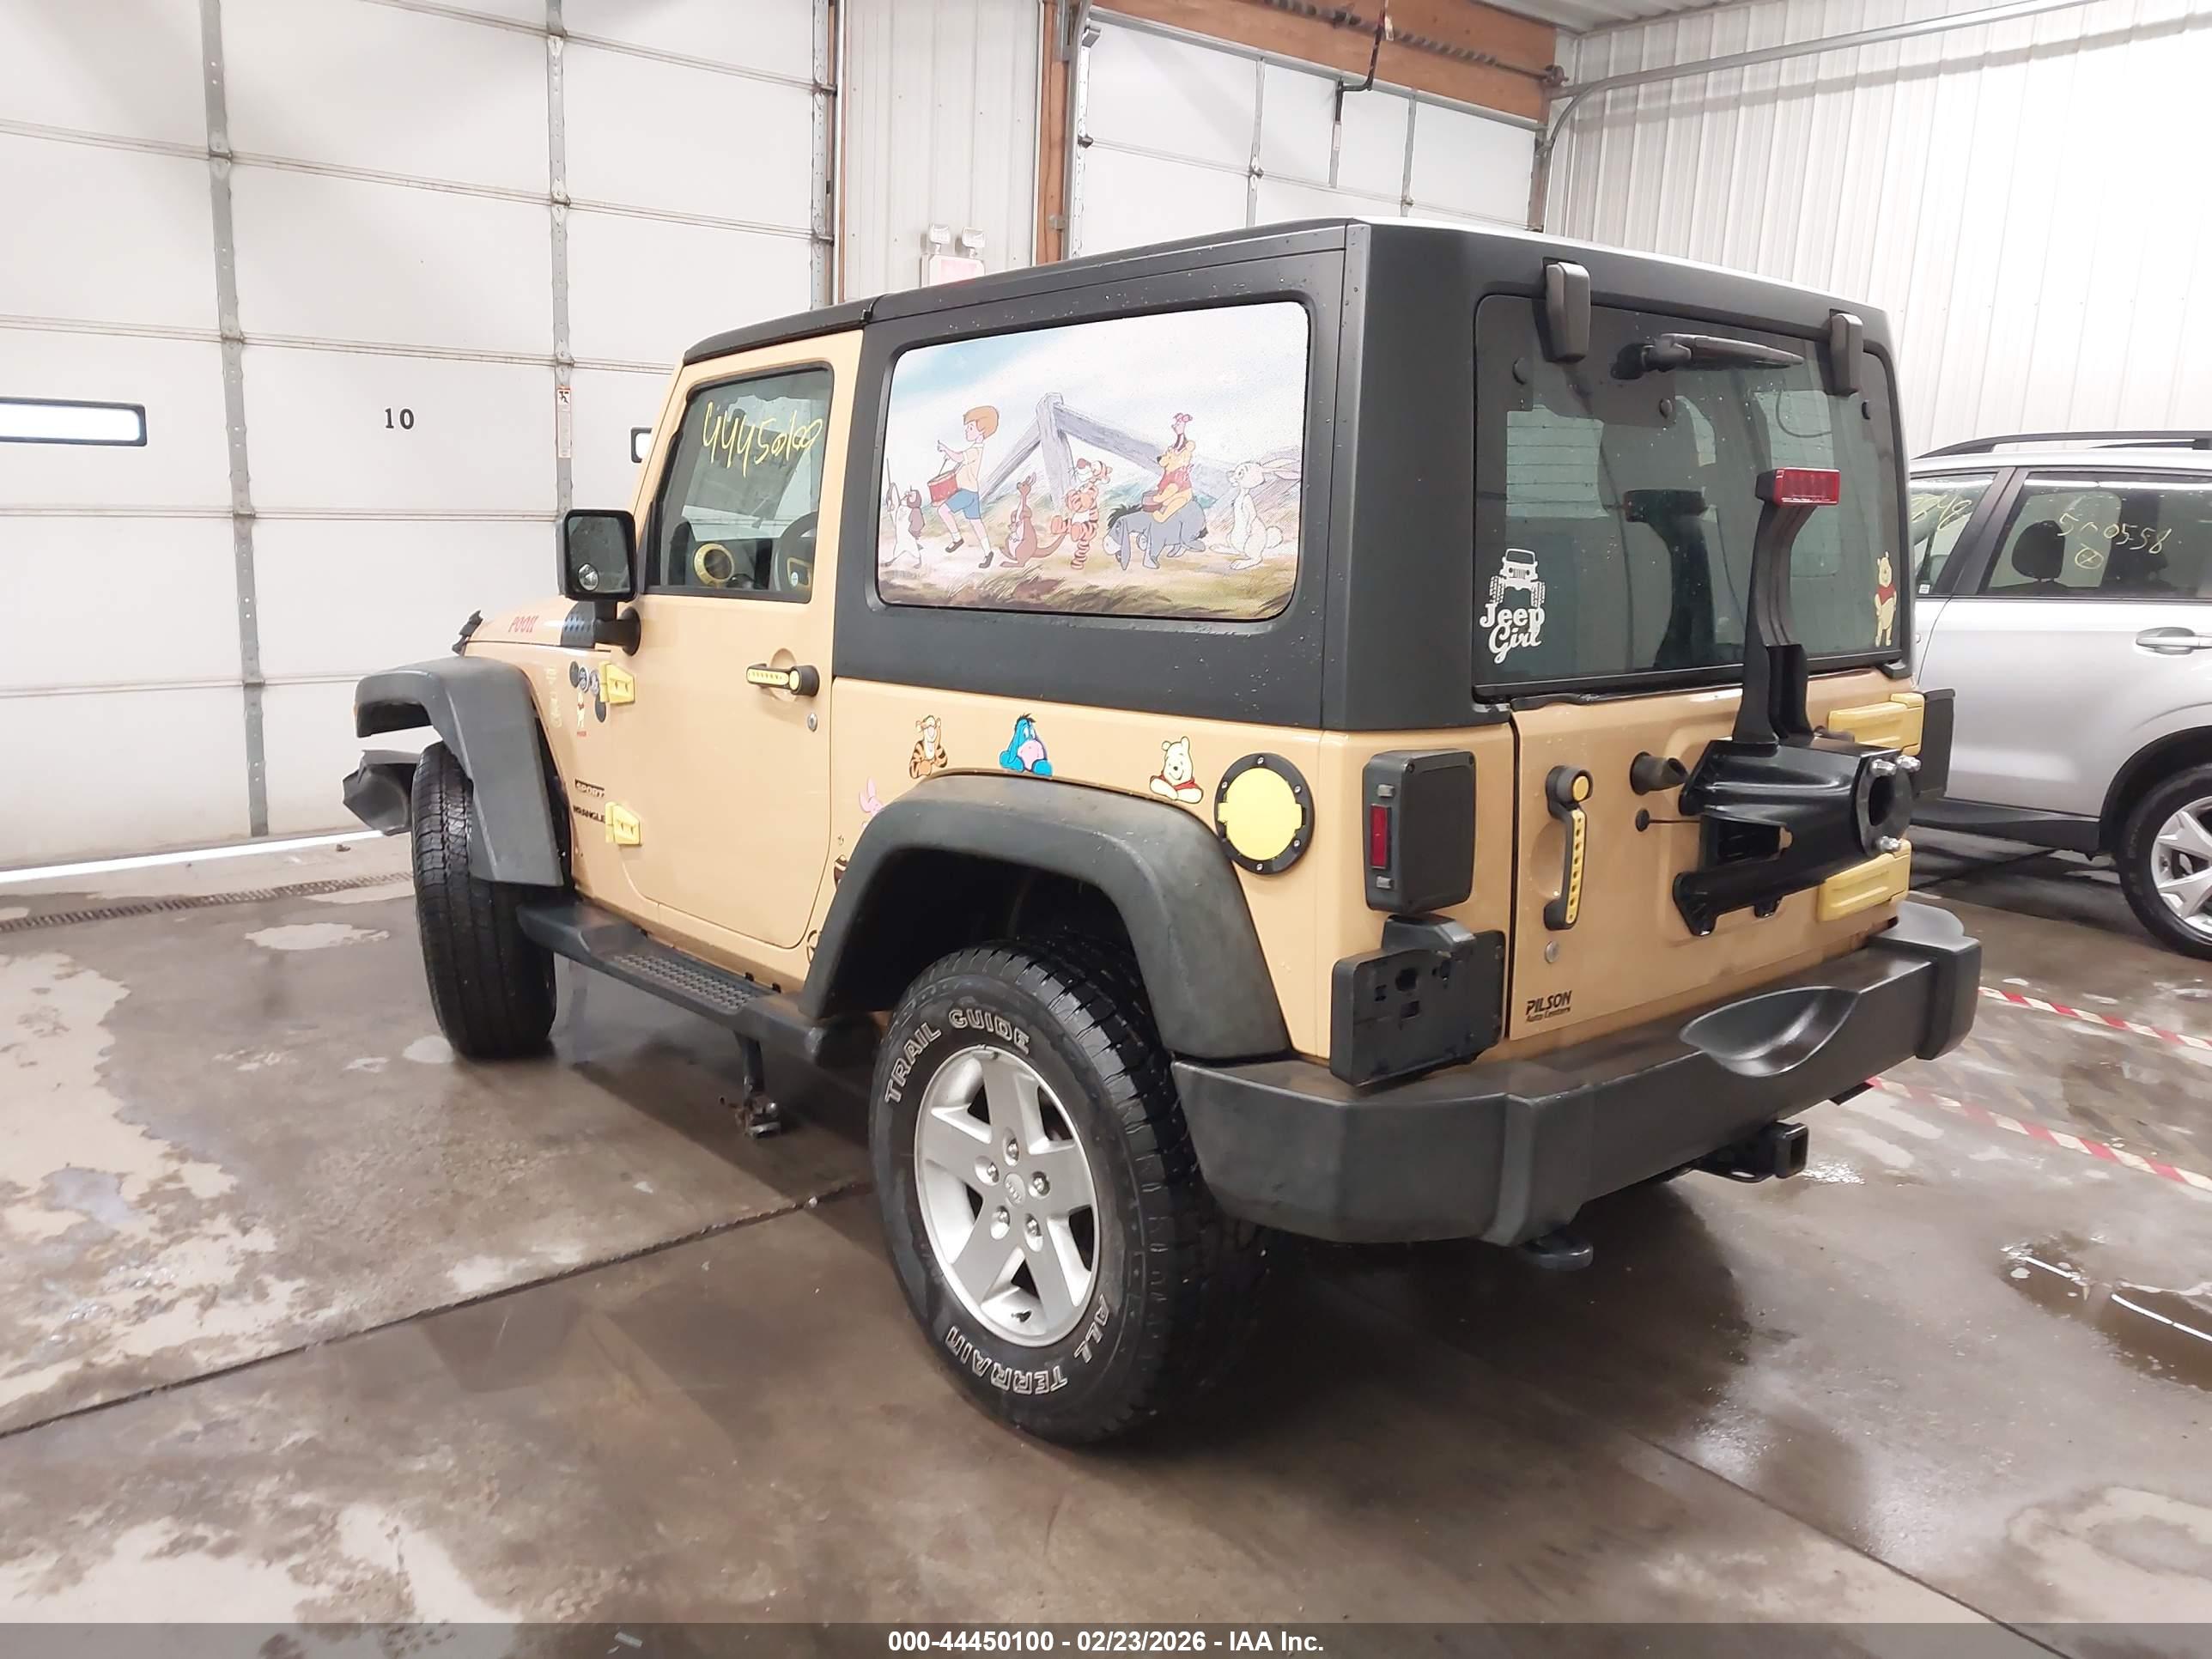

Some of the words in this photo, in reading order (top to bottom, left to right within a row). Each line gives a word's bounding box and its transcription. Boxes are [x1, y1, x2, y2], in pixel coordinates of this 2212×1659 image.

[385, 408, 414, 429] 10
[1480, 602, 1545, 633] Jeep
[1489, 624, 1541, 664] Girl
[573, 805, 605, 823] WRANGLE
[1526, 990, 1571, 1015] PILSON
[885, 1022, 942, 1103] TRAIL
[949, 1009, 1030, 1054] GUIDE
[1073, 1294, 1109, 1364] ALL
[945, 1326, 1068, 1395] TERRAIN
